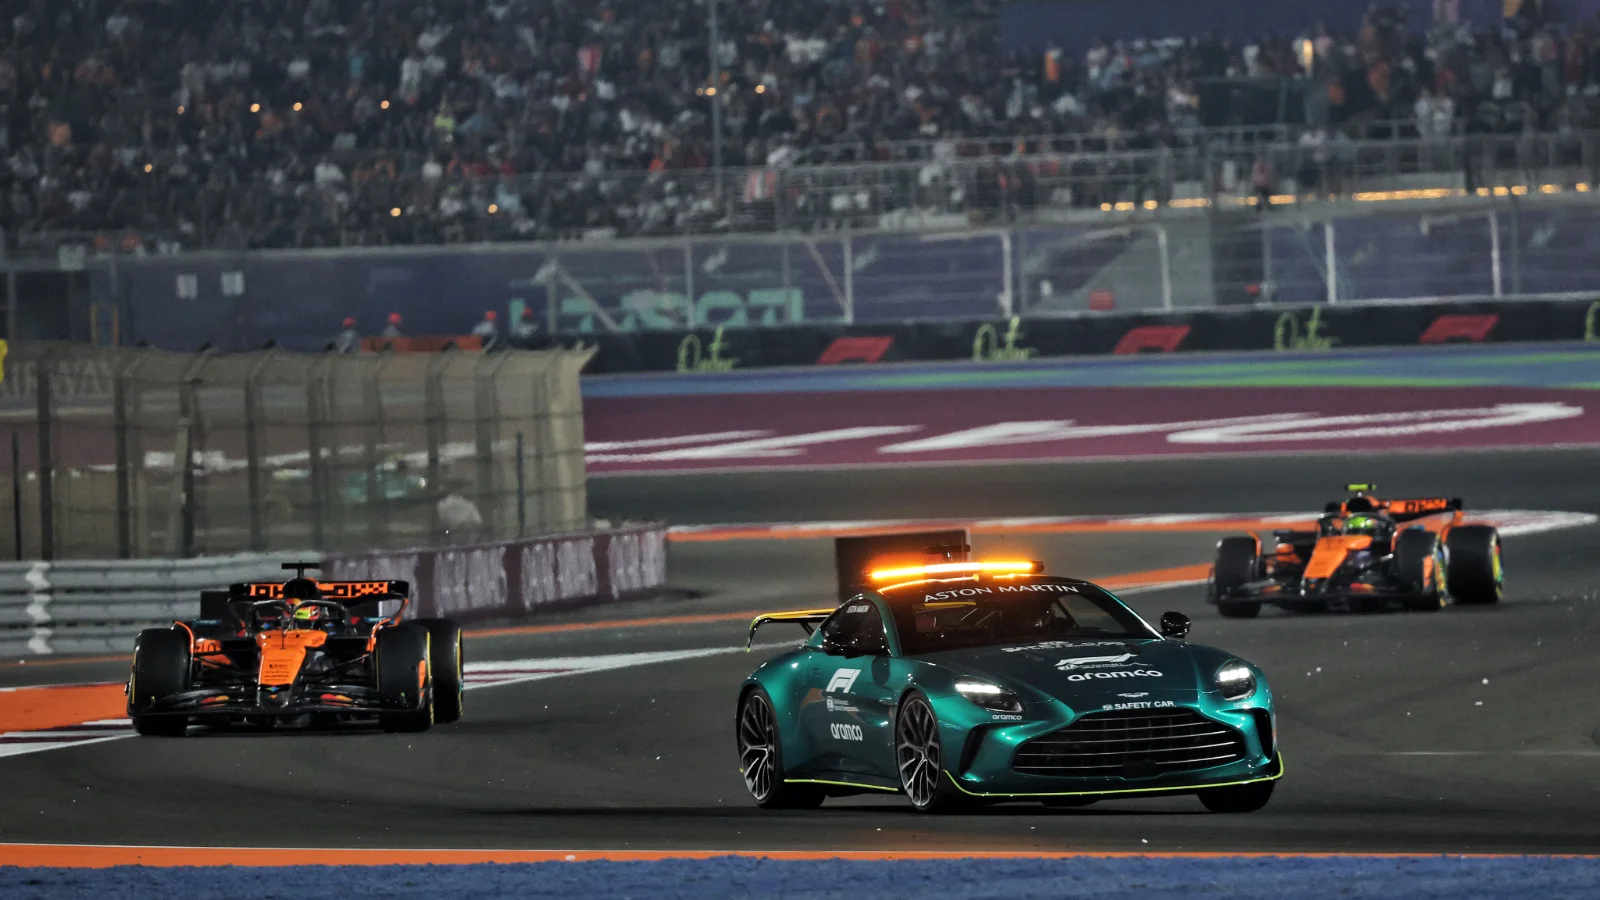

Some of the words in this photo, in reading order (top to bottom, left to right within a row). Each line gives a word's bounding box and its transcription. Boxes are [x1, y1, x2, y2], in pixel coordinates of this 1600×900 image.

[924, 586, 992, 602] ASTON
[998, 584, 1079, 593] MARTIN
[825, 668, 862, 693] F1
[1067, 669, 1163, 682] aramco
[1114, 701, 1152, 710] SAFETY
[830, 722, 863, 741] aramco
